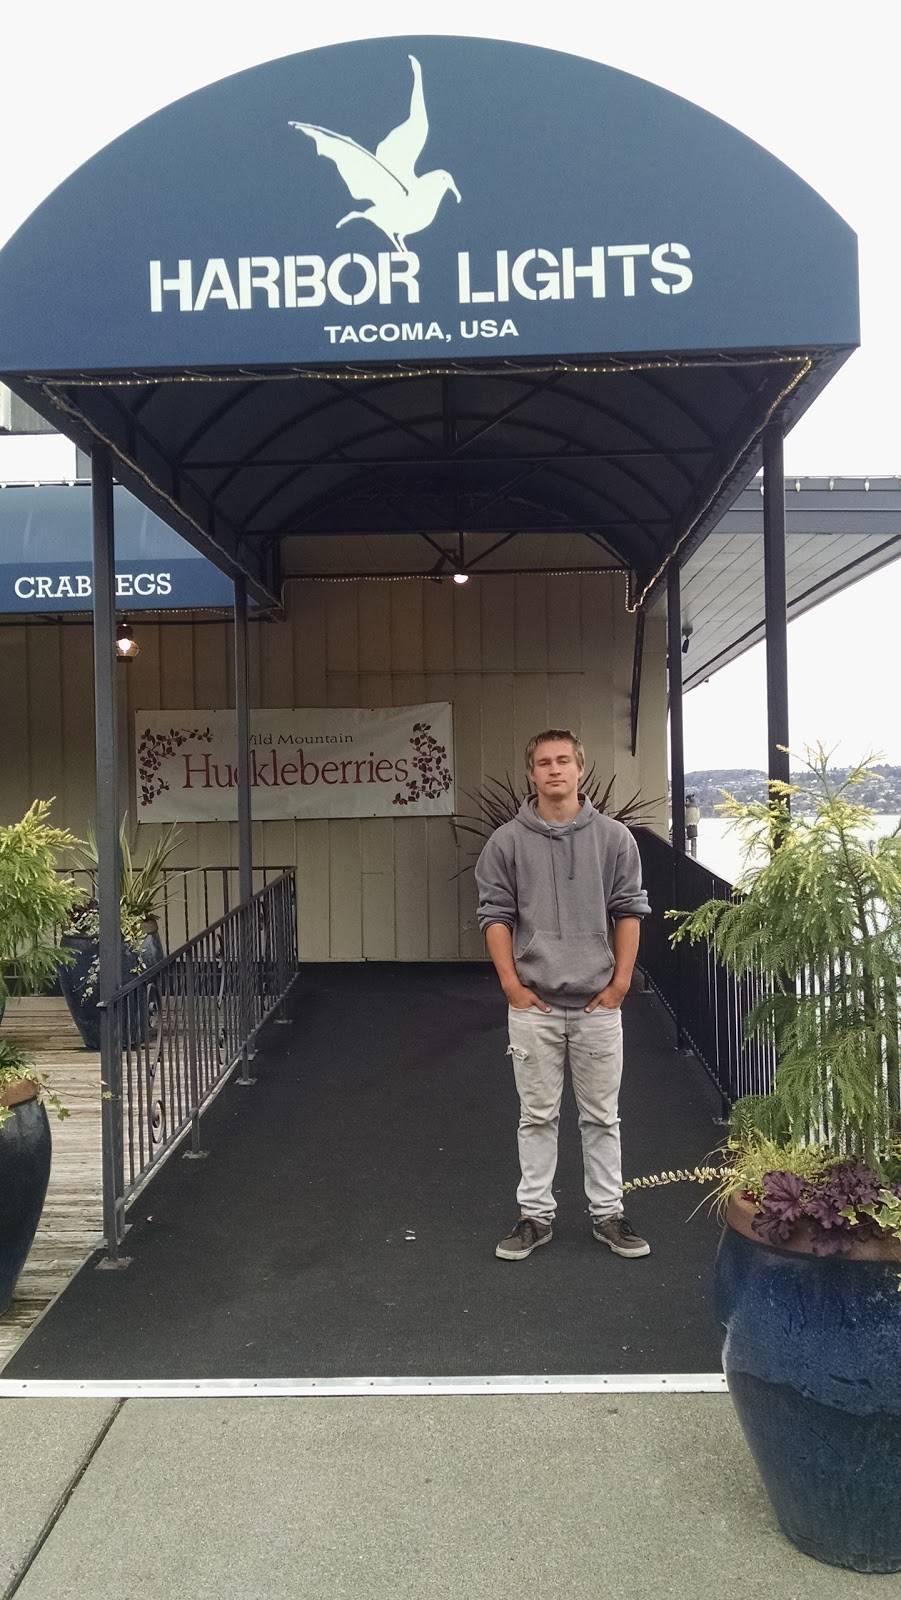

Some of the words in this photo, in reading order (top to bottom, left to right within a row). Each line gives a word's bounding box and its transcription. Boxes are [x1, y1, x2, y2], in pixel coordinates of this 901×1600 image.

[149, 251, 421, 313] HARBOR
[457, 242, 694, 304] LIGHTS
[323, 321, 452, 344] TACOMA,
[460, 318, 520, 339] USA
[14, 575, 92, 599] CRAB
[115, 572, 172, 596] EGS
[248, 733, 273, 745] ild
[277, 732, 354, 746] Mountain
